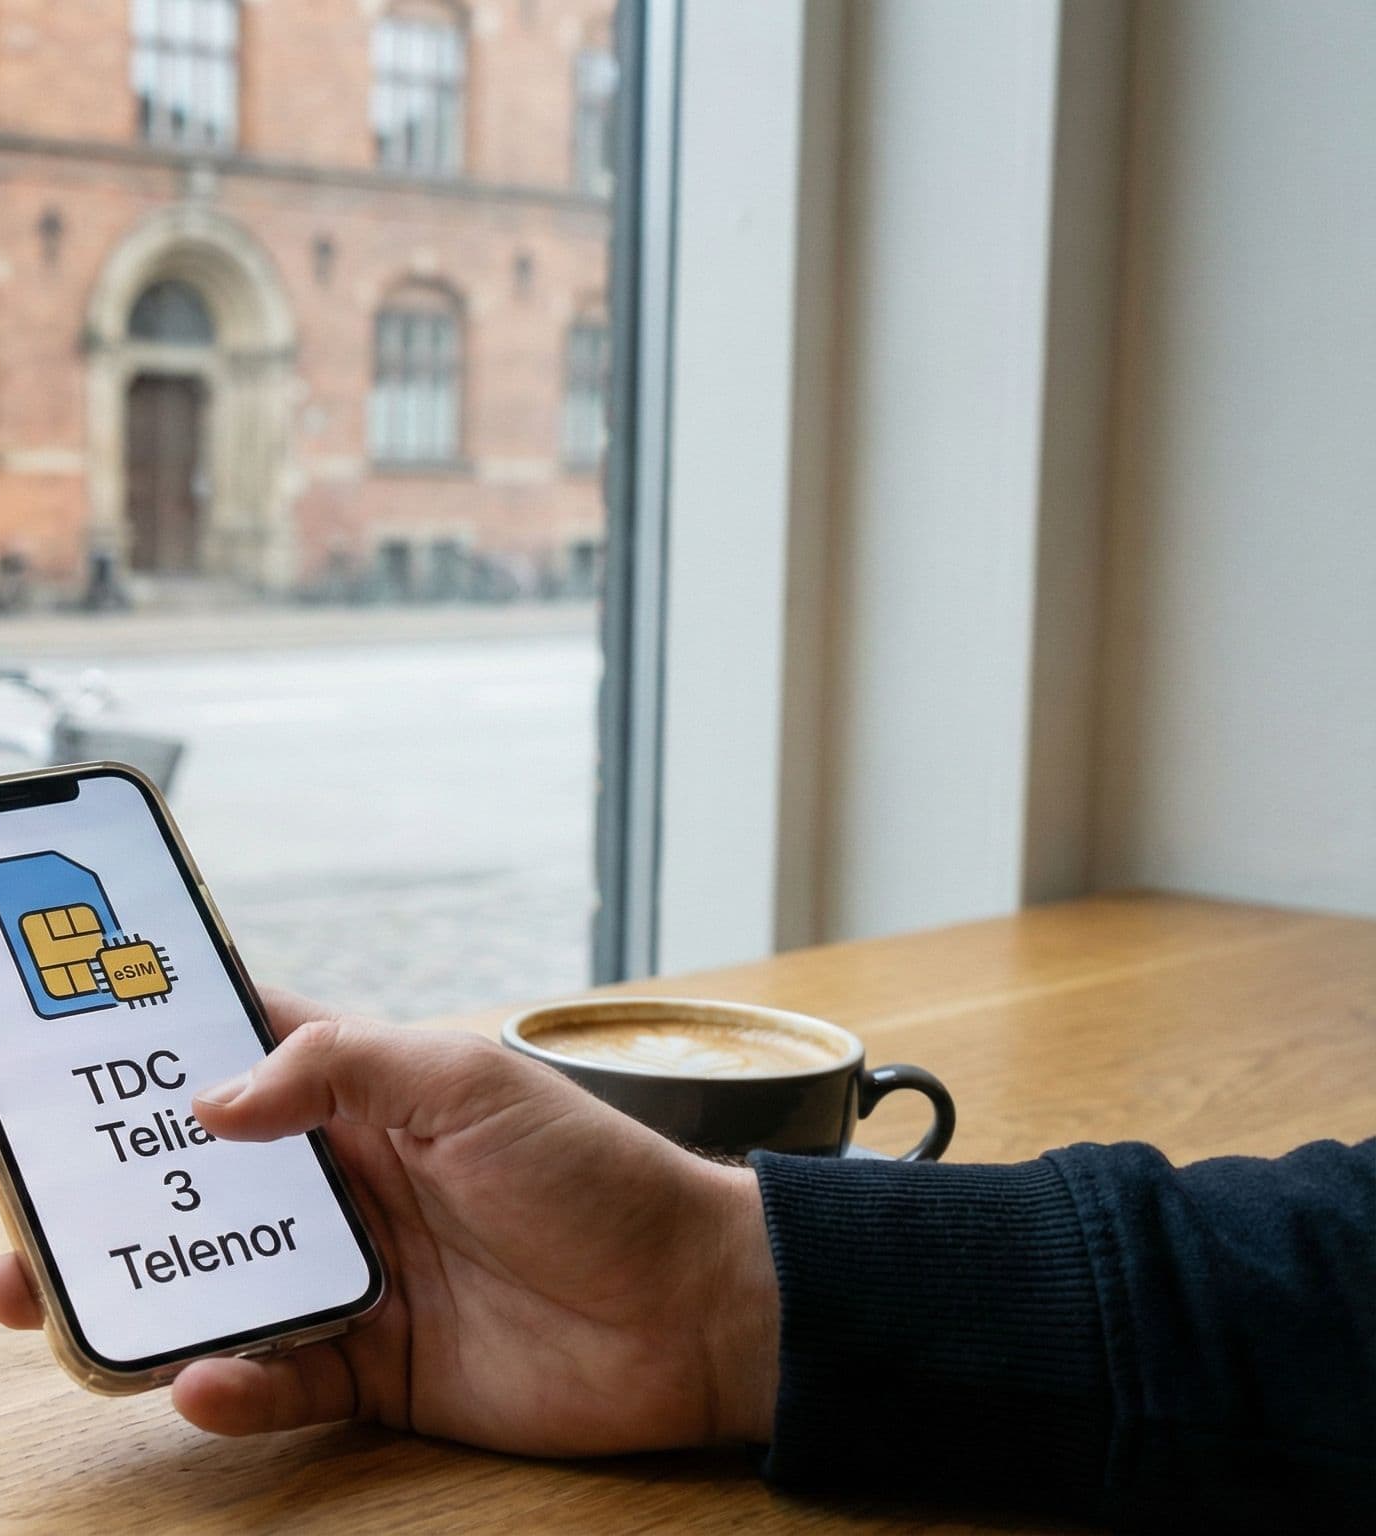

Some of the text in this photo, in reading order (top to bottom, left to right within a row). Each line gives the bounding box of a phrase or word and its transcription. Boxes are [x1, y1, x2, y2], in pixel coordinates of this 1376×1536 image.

[114, 961, 156, 980] eSIM
[72, 1050, 186, 1105] TDC
[95, 1109, 216, 1162] Telia
[164, 1170, 201, 1212] 3
[109, 1217, 297, 1290] Telenor
